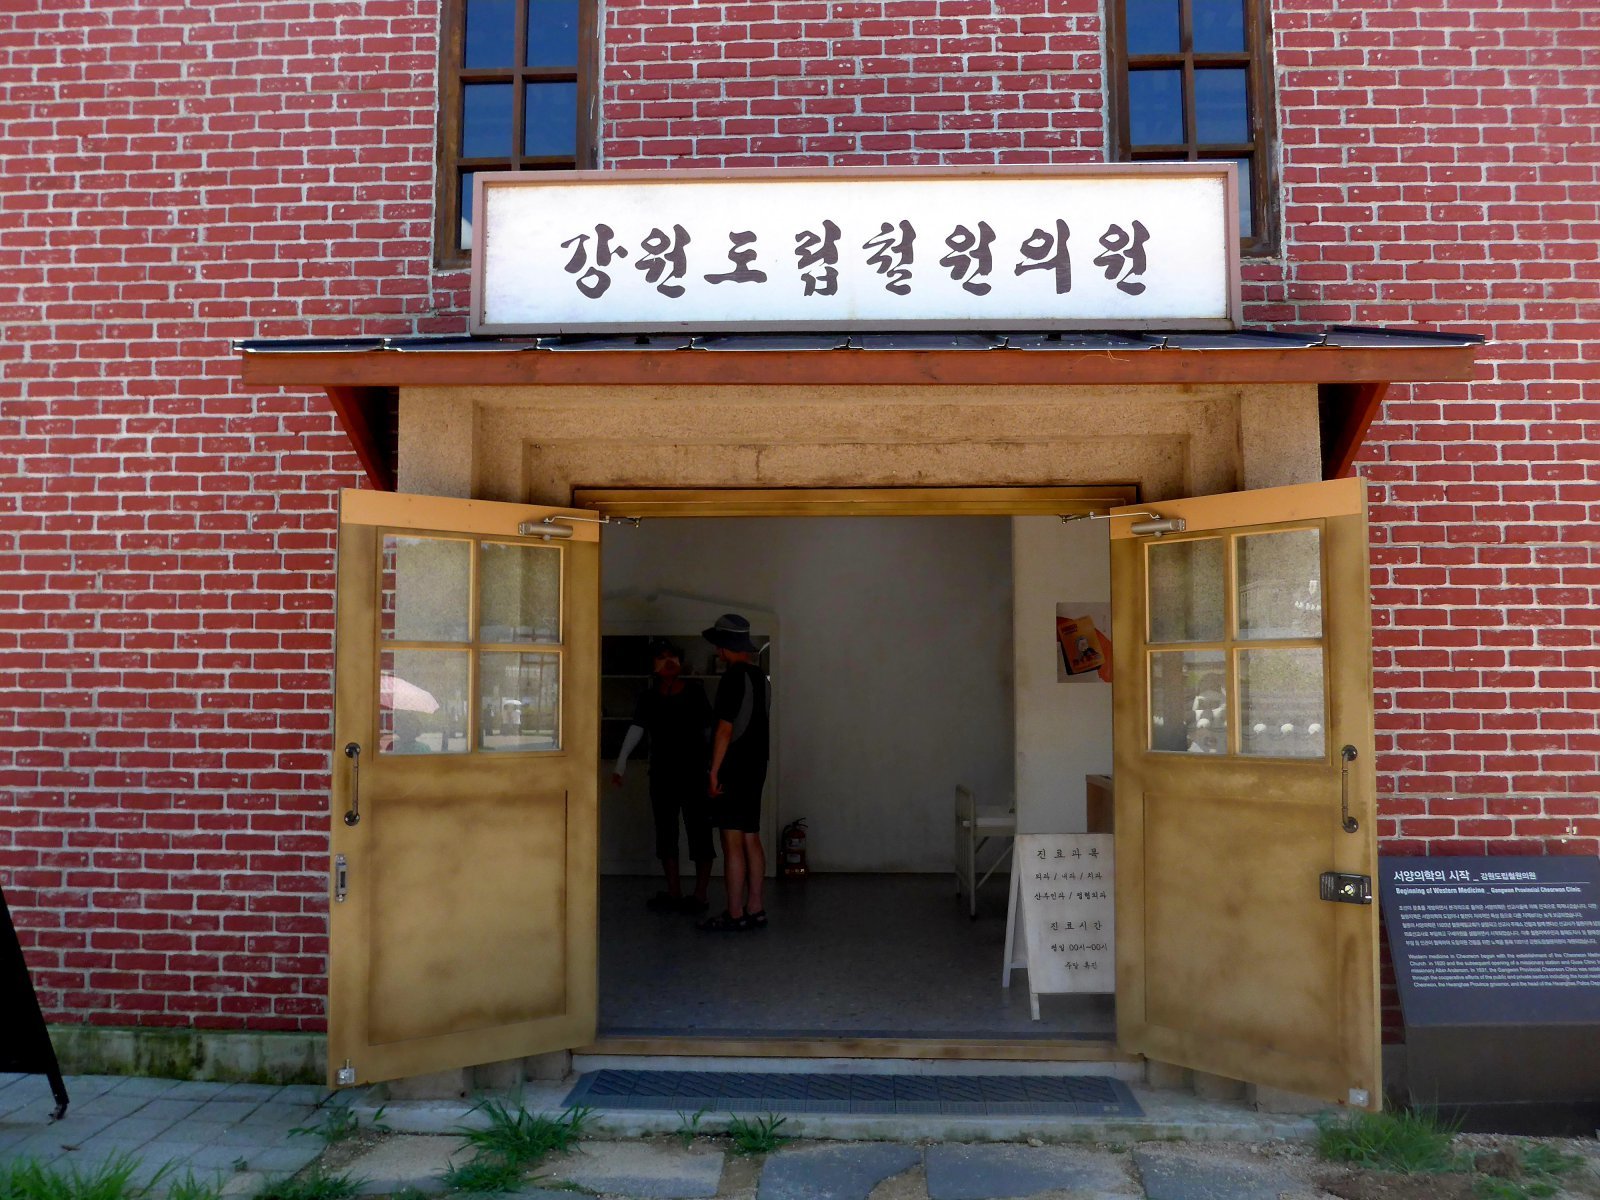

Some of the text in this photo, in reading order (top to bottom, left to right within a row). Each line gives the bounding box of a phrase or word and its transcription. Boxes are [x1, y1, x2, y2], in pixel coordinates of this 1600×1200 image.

[561, 218, 1151, 298] 강원도립철원의원
[1394, 870, 1446, 881] 서양의학의
[1449, 870, 1470, 881] 시작
